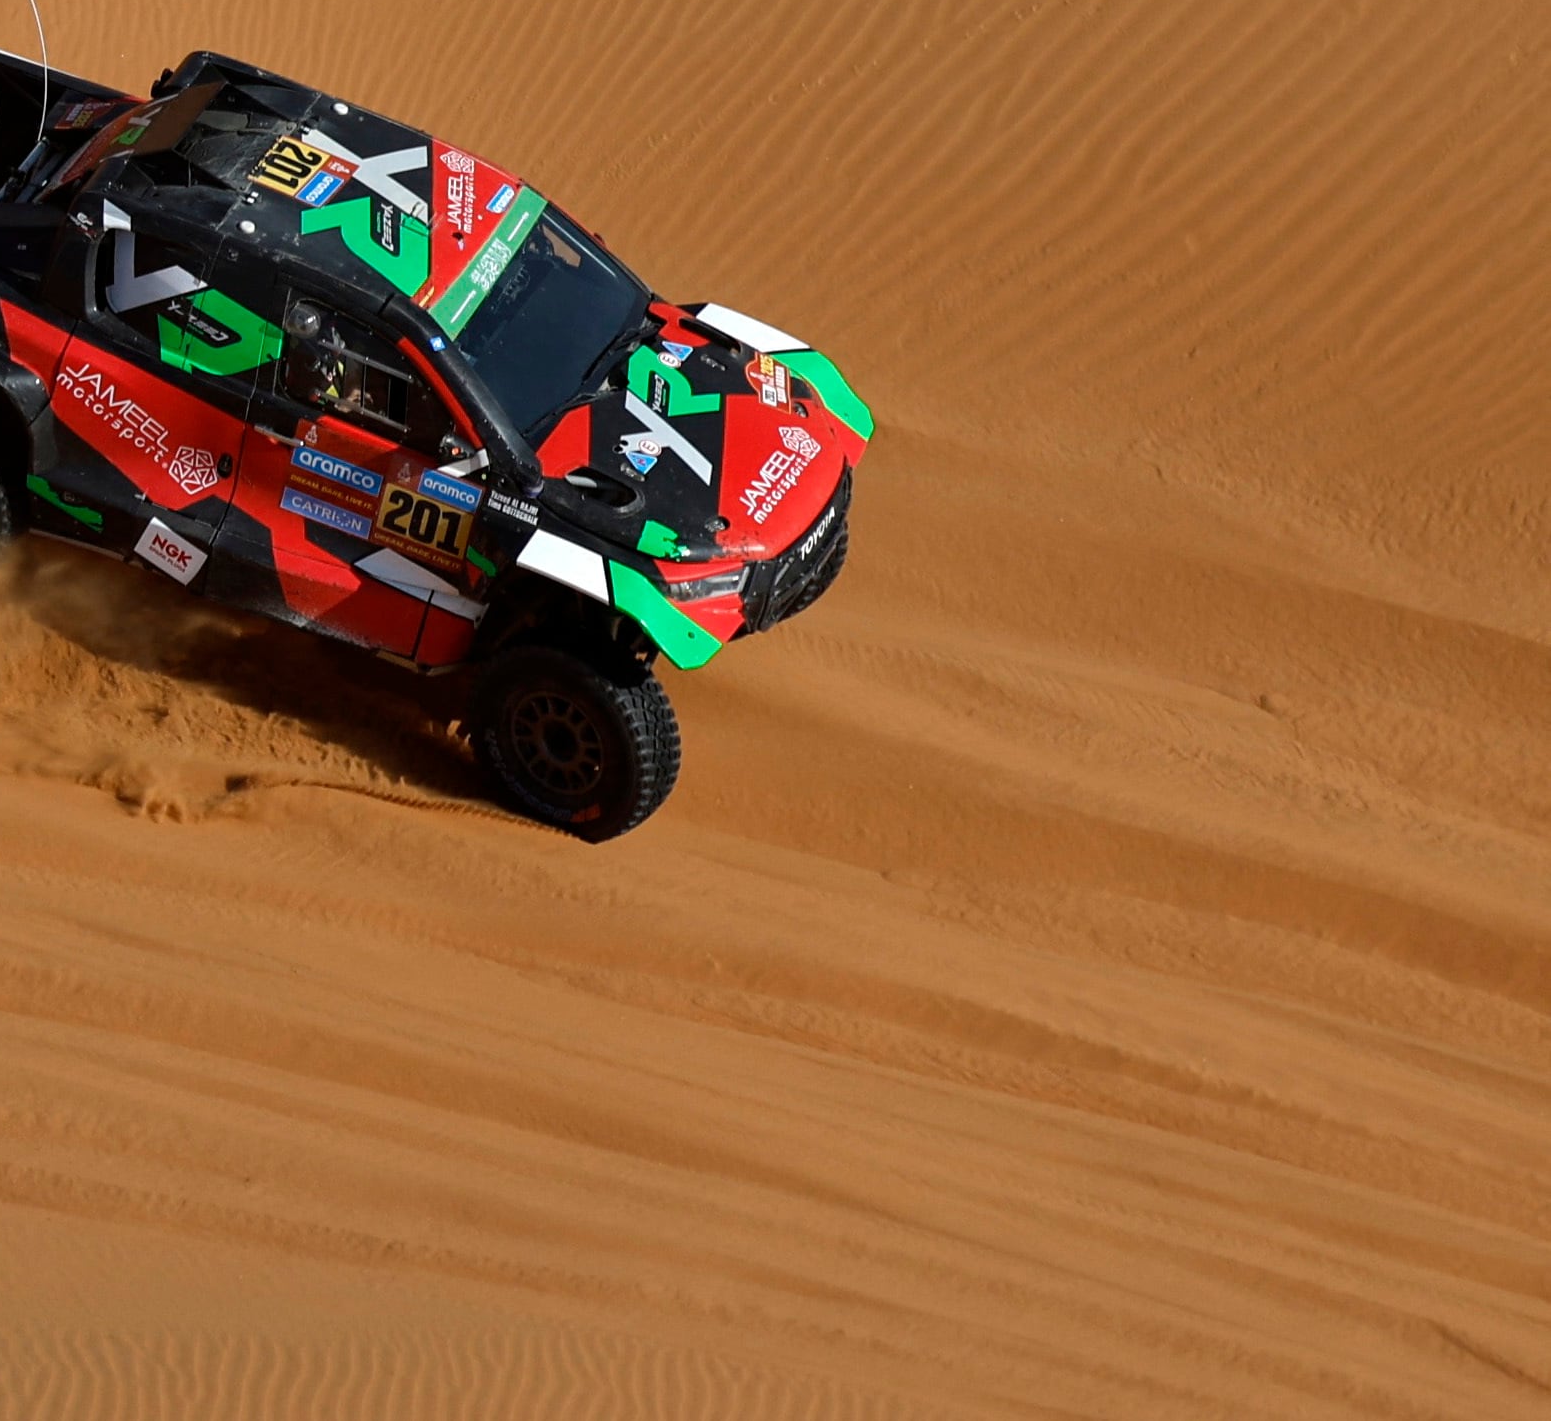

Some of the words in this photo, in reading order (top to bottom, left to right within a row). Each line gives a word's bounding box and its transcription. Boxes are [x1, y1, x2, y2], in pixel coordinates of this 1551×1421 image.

[255, 138, 323, 189] 201
[448, 174, 464, 230] JAMEEL
[66, 364, 169, 452] JAMEEL
[299, 451, 375, 490] aramco
[424, 478, 475, 505] aramco
[739, 450, 796, 515] JAMEEL
[152, 533, 193, 568] NGK
[383, 490, 463, 555] 201
[800, 505, 836, 561] TOYOTA
